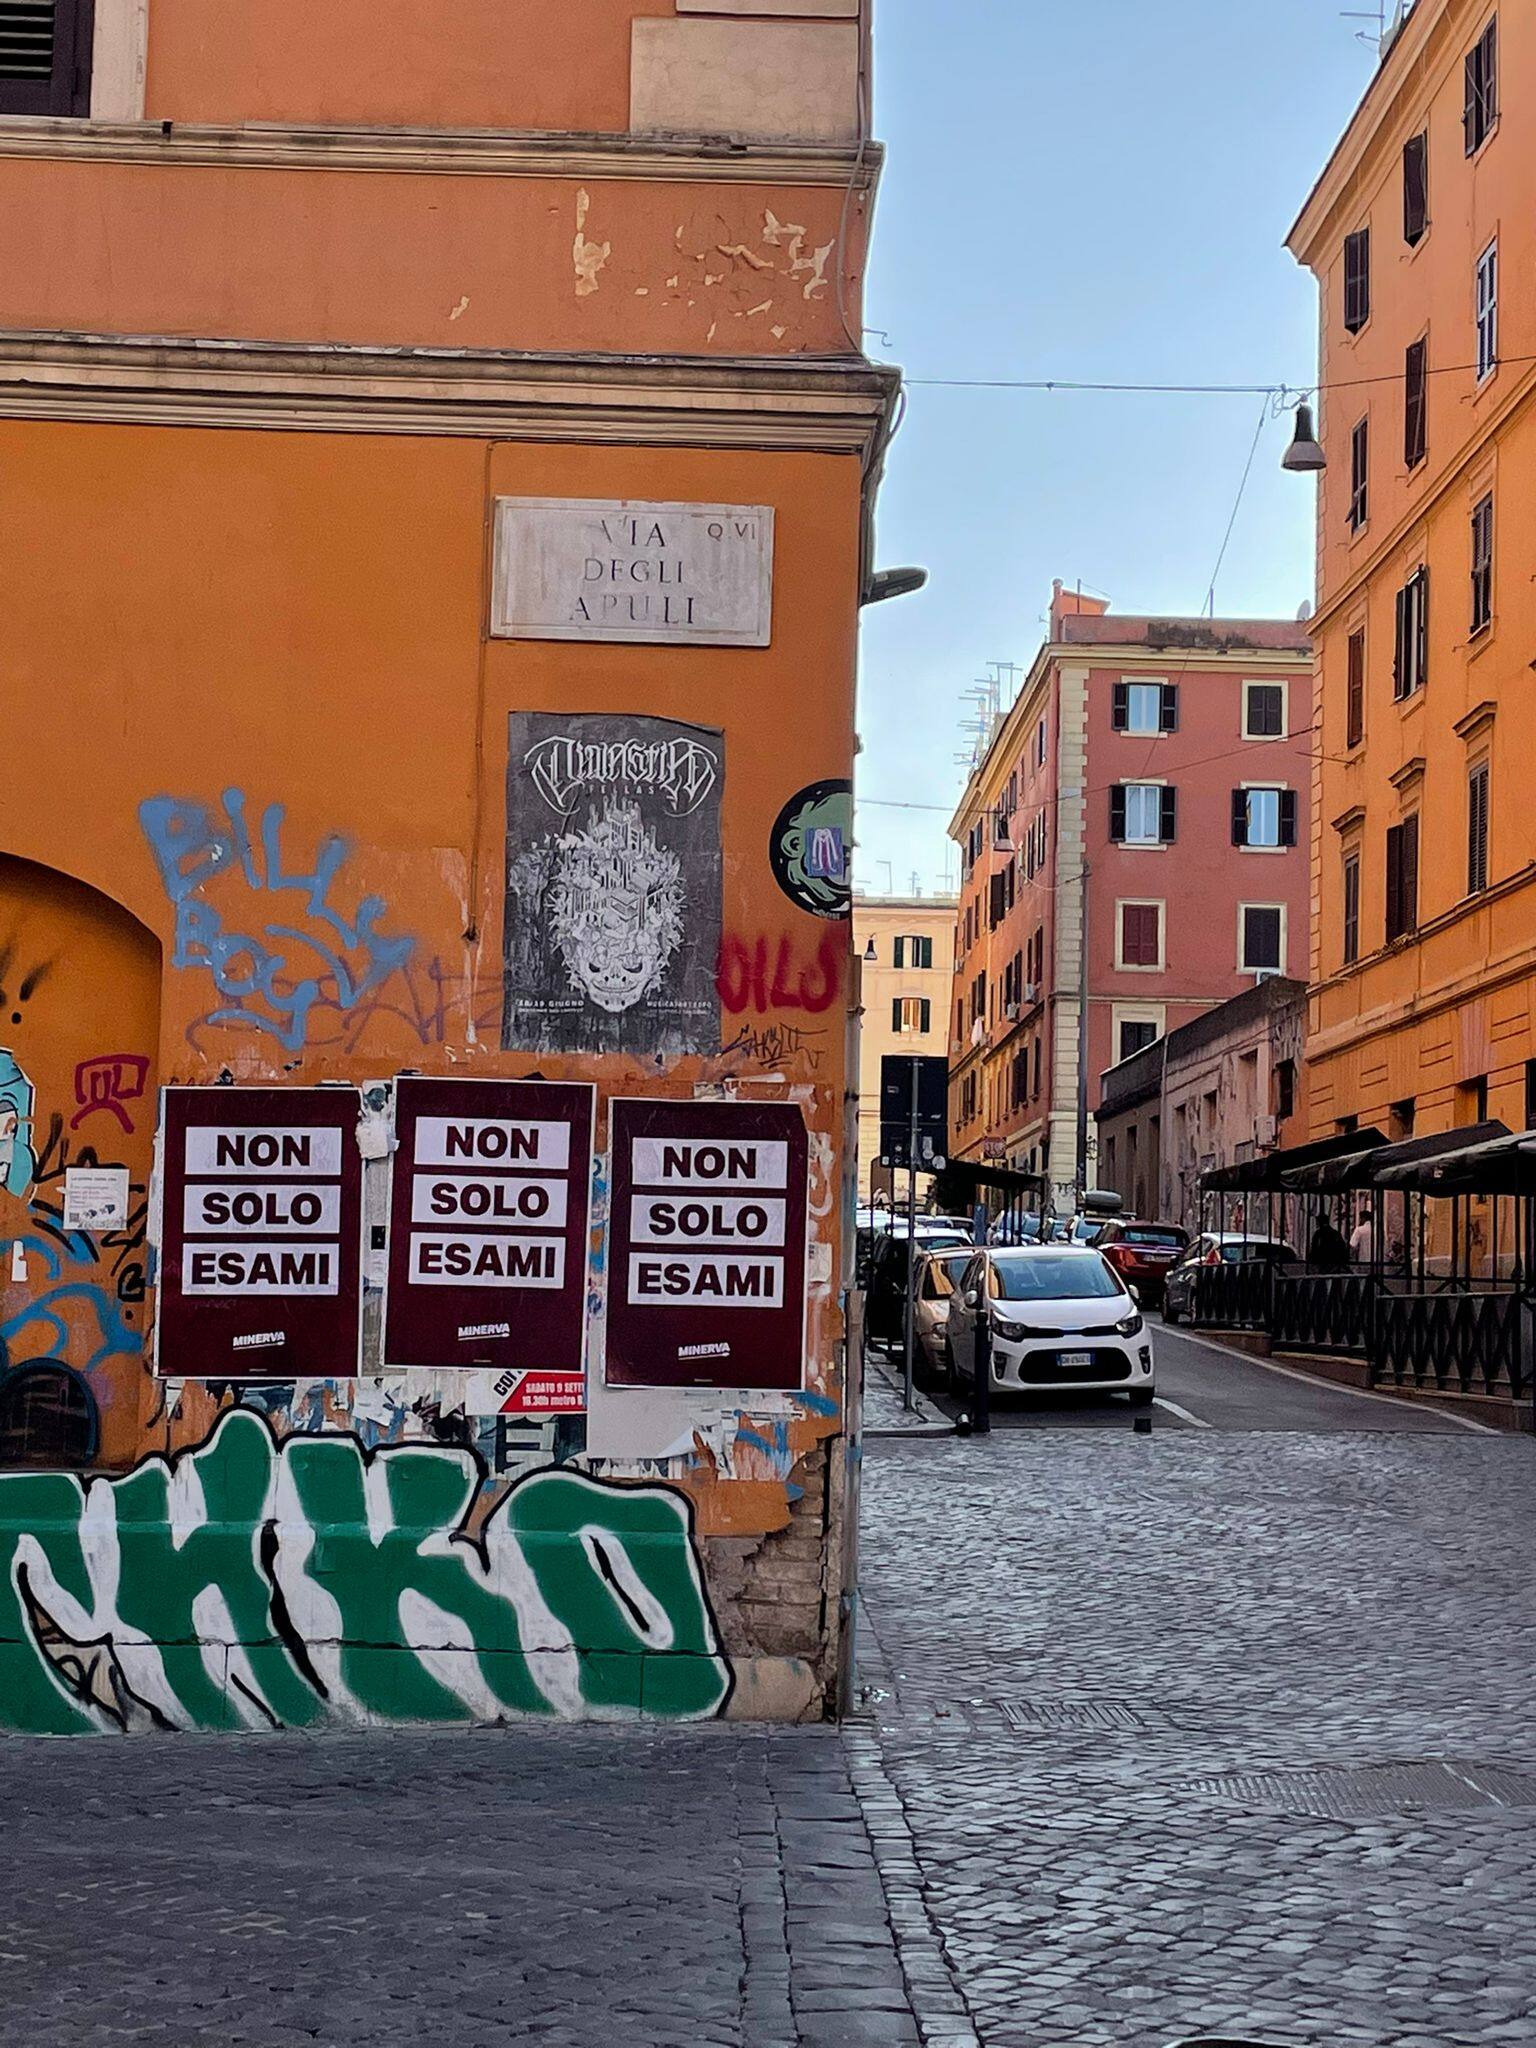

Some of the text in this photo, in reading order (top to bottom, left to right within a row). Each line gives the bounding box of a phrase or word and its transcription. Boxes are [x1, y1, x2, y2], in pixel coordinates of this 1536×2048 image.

[601, 517, 667, 547] VIA
[584, 558, 683, 584] DEGLI
[569, 596, 695, 624] APULI
[217, 1135, 311, 1166] NON
[445, 1126, 539, 1159] NON
[662, 1146, 757, 1179] NON
[202, 1192, 322, 1225] SOLO
[430, 1183, 550, 1218] SOLO
[648, 1203, 769, 1238] SOLO
[191, 1253, 330, 1285] ESAMI
[418, 1243, 556, 1278] ESAMI
[637, 1262, 775, 1297] ESAMI
[232, 1331, 286, 1347] MINERVA
[458, 1322, 510, 1338] MINERVA
[678, 1342, 731, 1357] MINERVA
[525, 1382, 555, 1394] SABATO
[551, 1395, 576, 1406] metro
